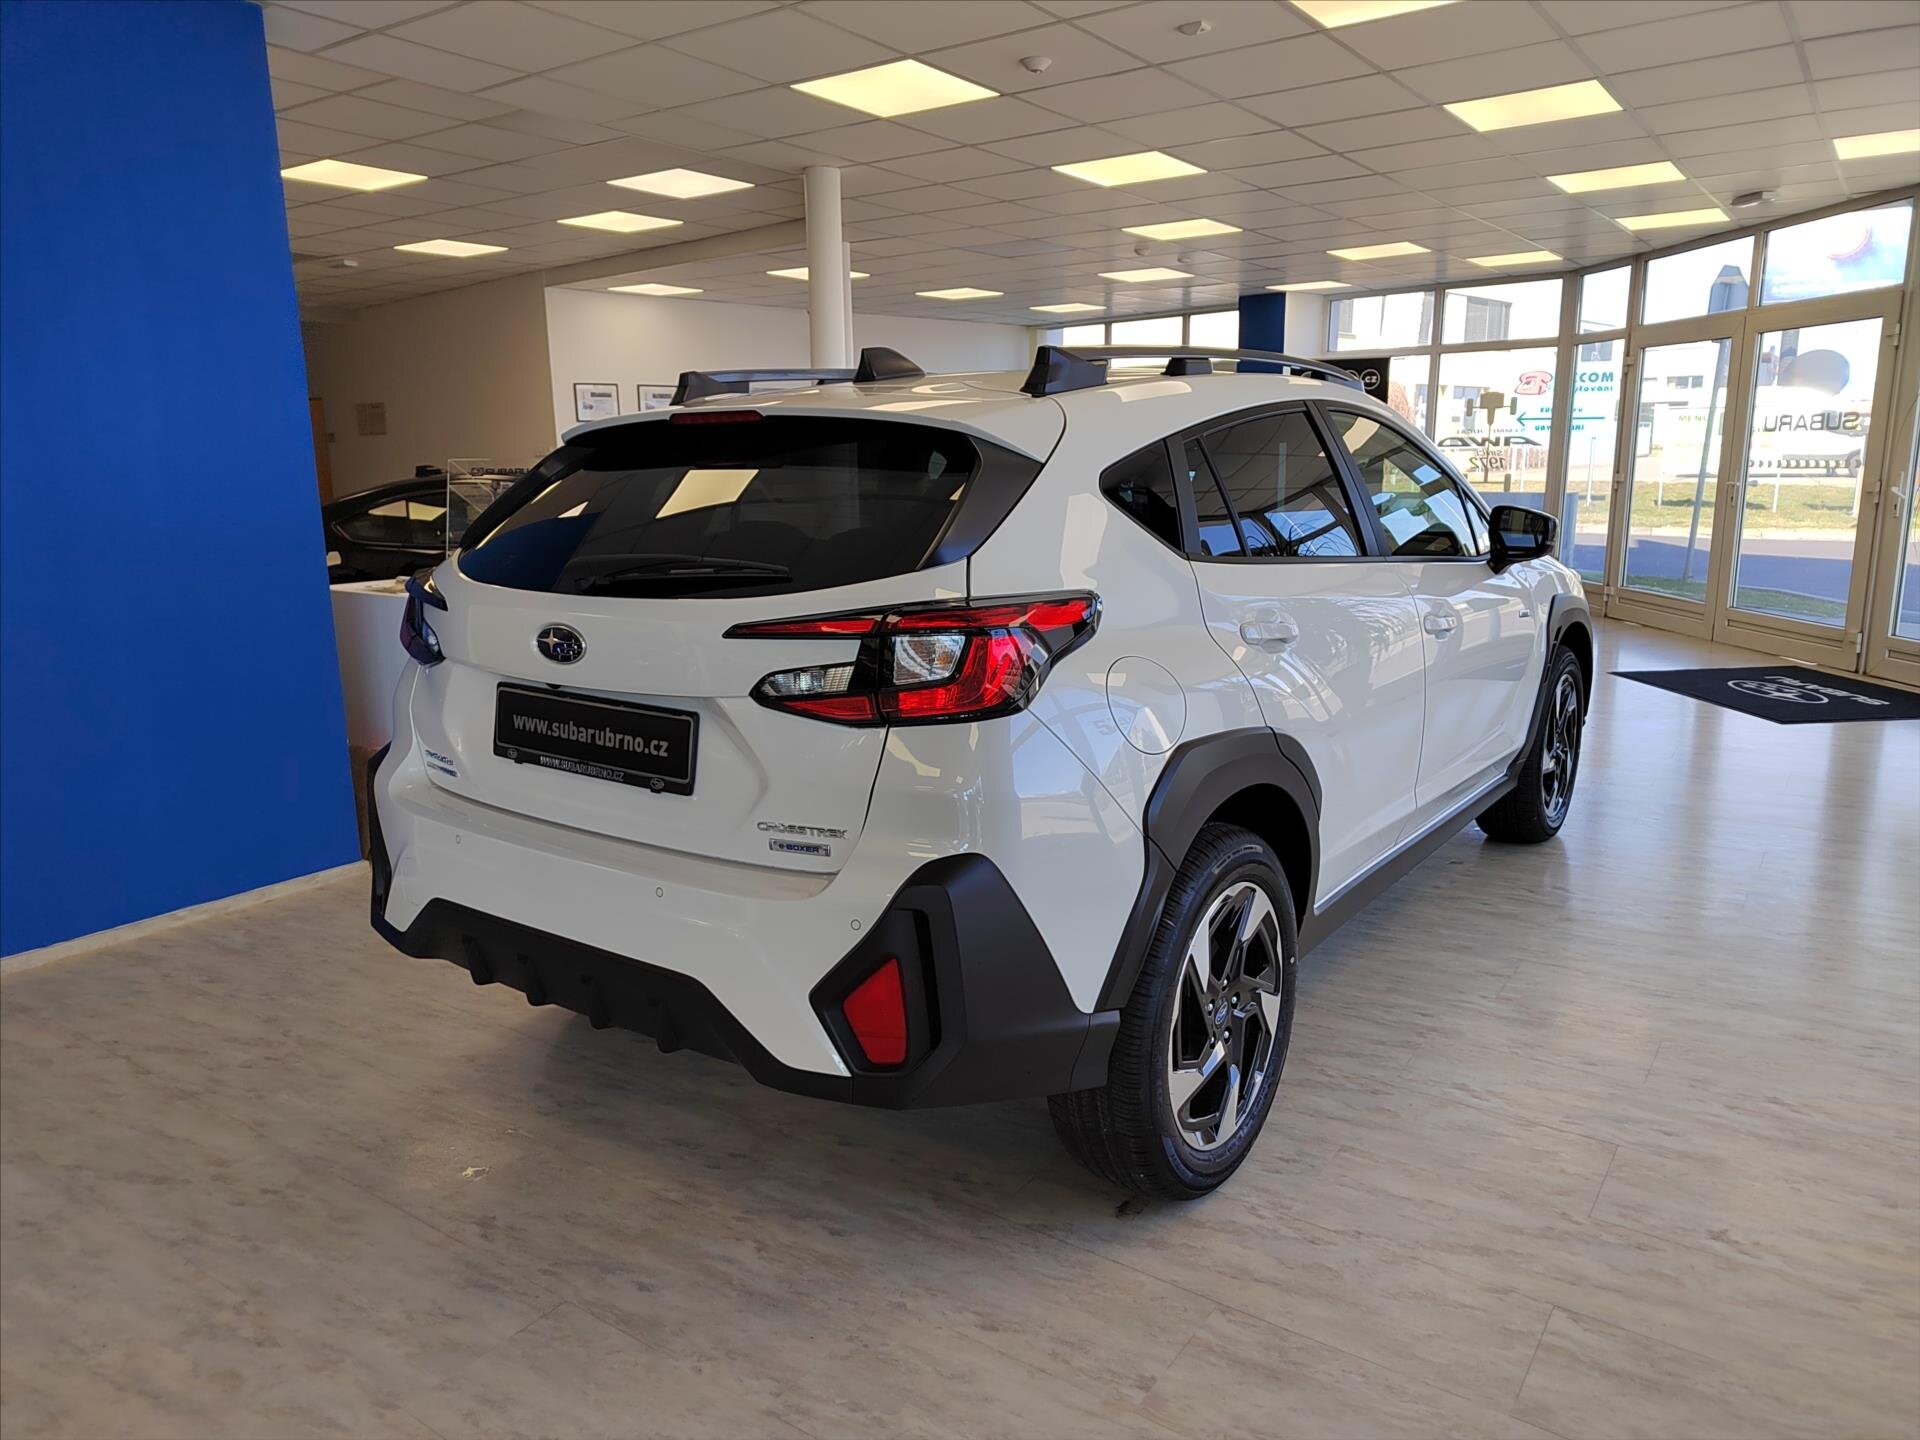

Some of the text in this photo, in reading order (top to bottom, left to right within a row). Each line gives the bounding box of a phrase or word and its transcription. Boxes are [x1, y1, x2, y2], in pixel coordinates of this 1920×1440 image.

[1576, 371, 1614, 383] COM
[512, 714, 669, 757] www.subarubrno.cz
[540, 755, 624, 781] WWW.SUBARUBRNO.CZ
[757, 821, 848, 839] CROSSTREK
[778, 843, 819, 853] e-BOXER
